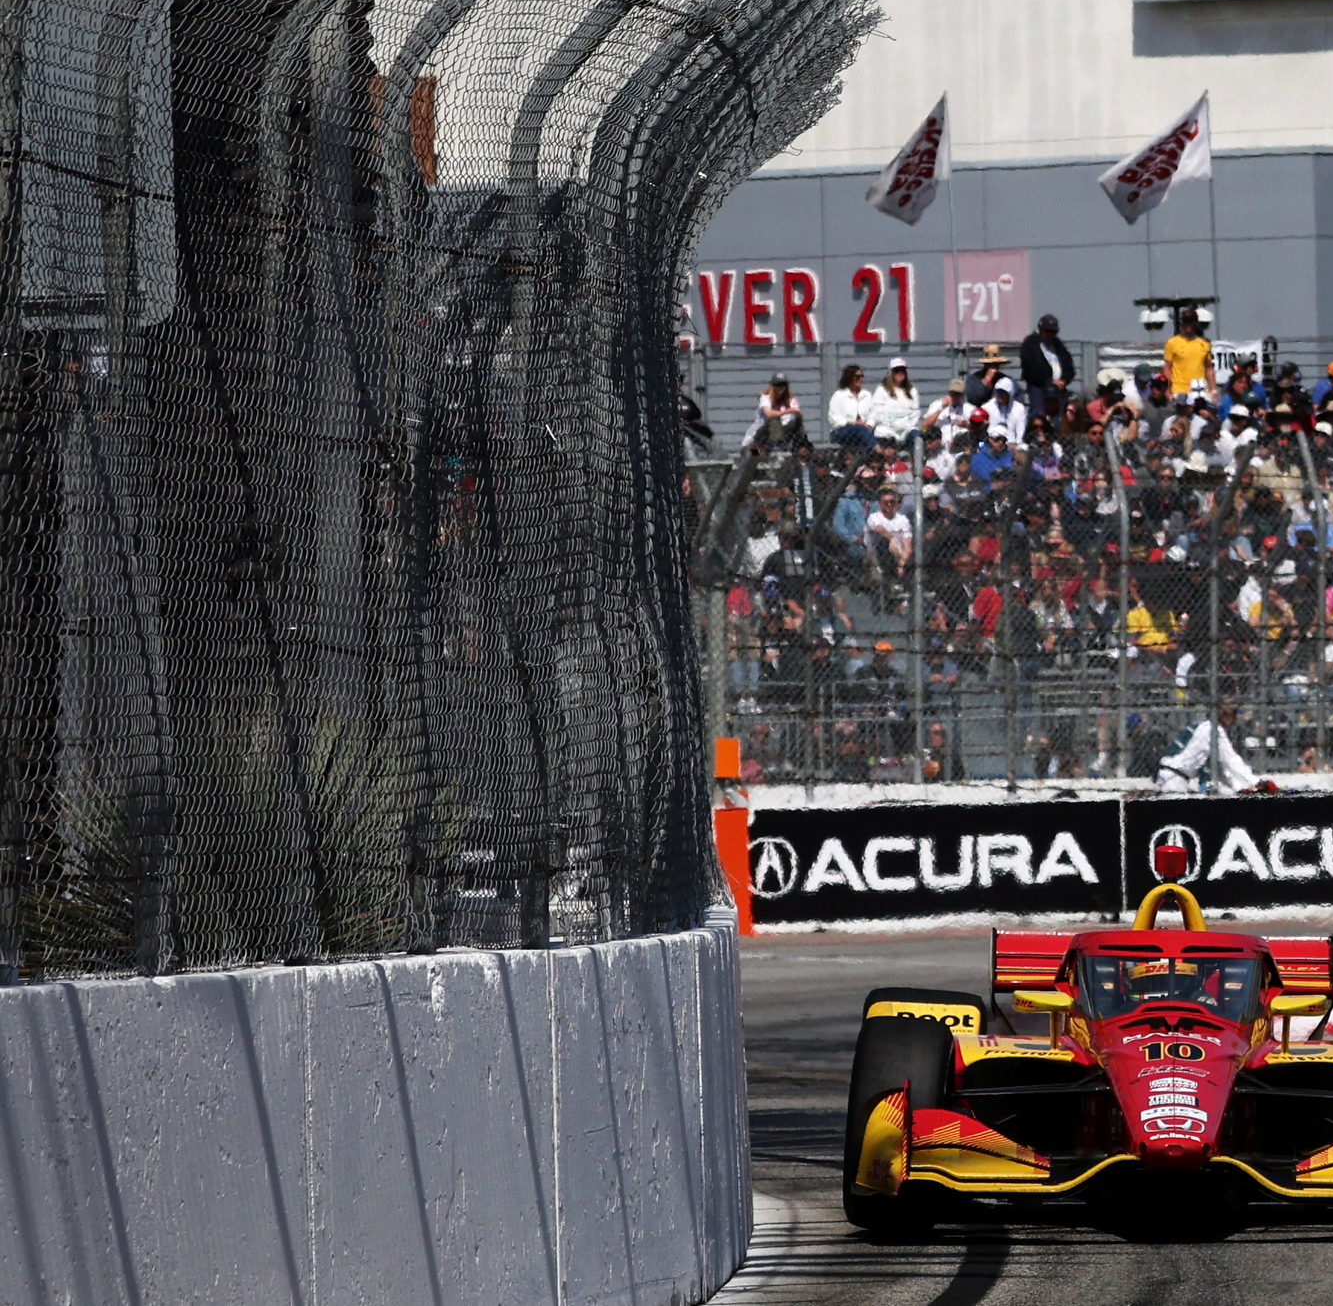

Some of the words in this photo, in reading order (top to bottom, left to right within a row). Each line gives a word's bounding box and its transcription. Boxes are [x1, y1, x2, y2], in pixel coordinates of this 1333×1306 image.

[678, 267, 821, 351] VER
[851, 262, 915, 344] 21
[957, 281, 999, 323] F21
[804, 831, 1099, 893] ACURA
[1138, 1040, 1206, 1062] 10
